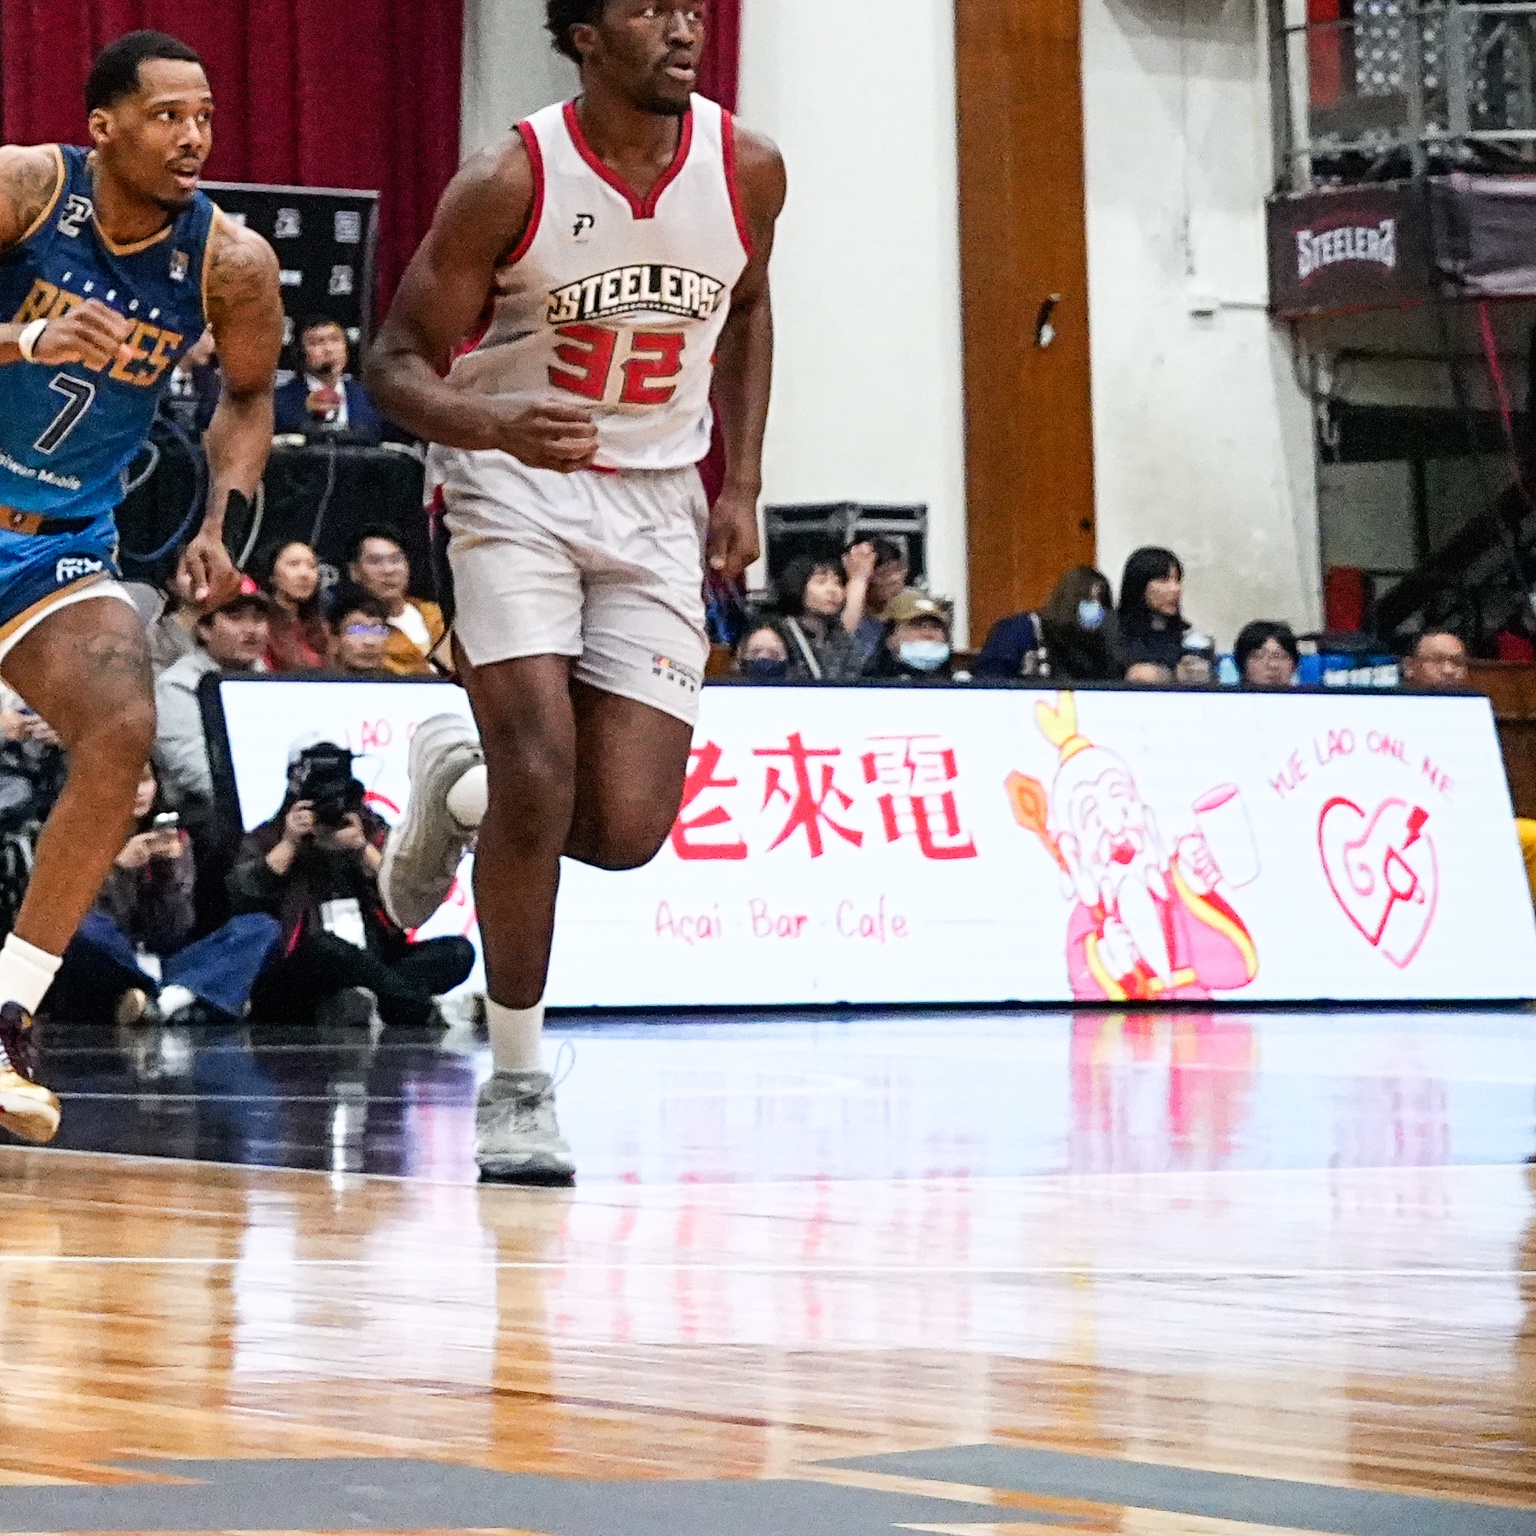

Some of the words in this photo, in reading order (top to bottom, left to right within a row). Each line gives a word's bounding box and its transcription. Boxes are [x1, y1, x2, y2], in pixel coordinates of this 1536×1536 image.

[550, 266, 721, 322] STEELERS
[548, 324, 686, 405] 32
[33, 372, 96, 455] 7
[749, 897, 809, 939] Bar
[835, 893, 911, 945] Cafe
